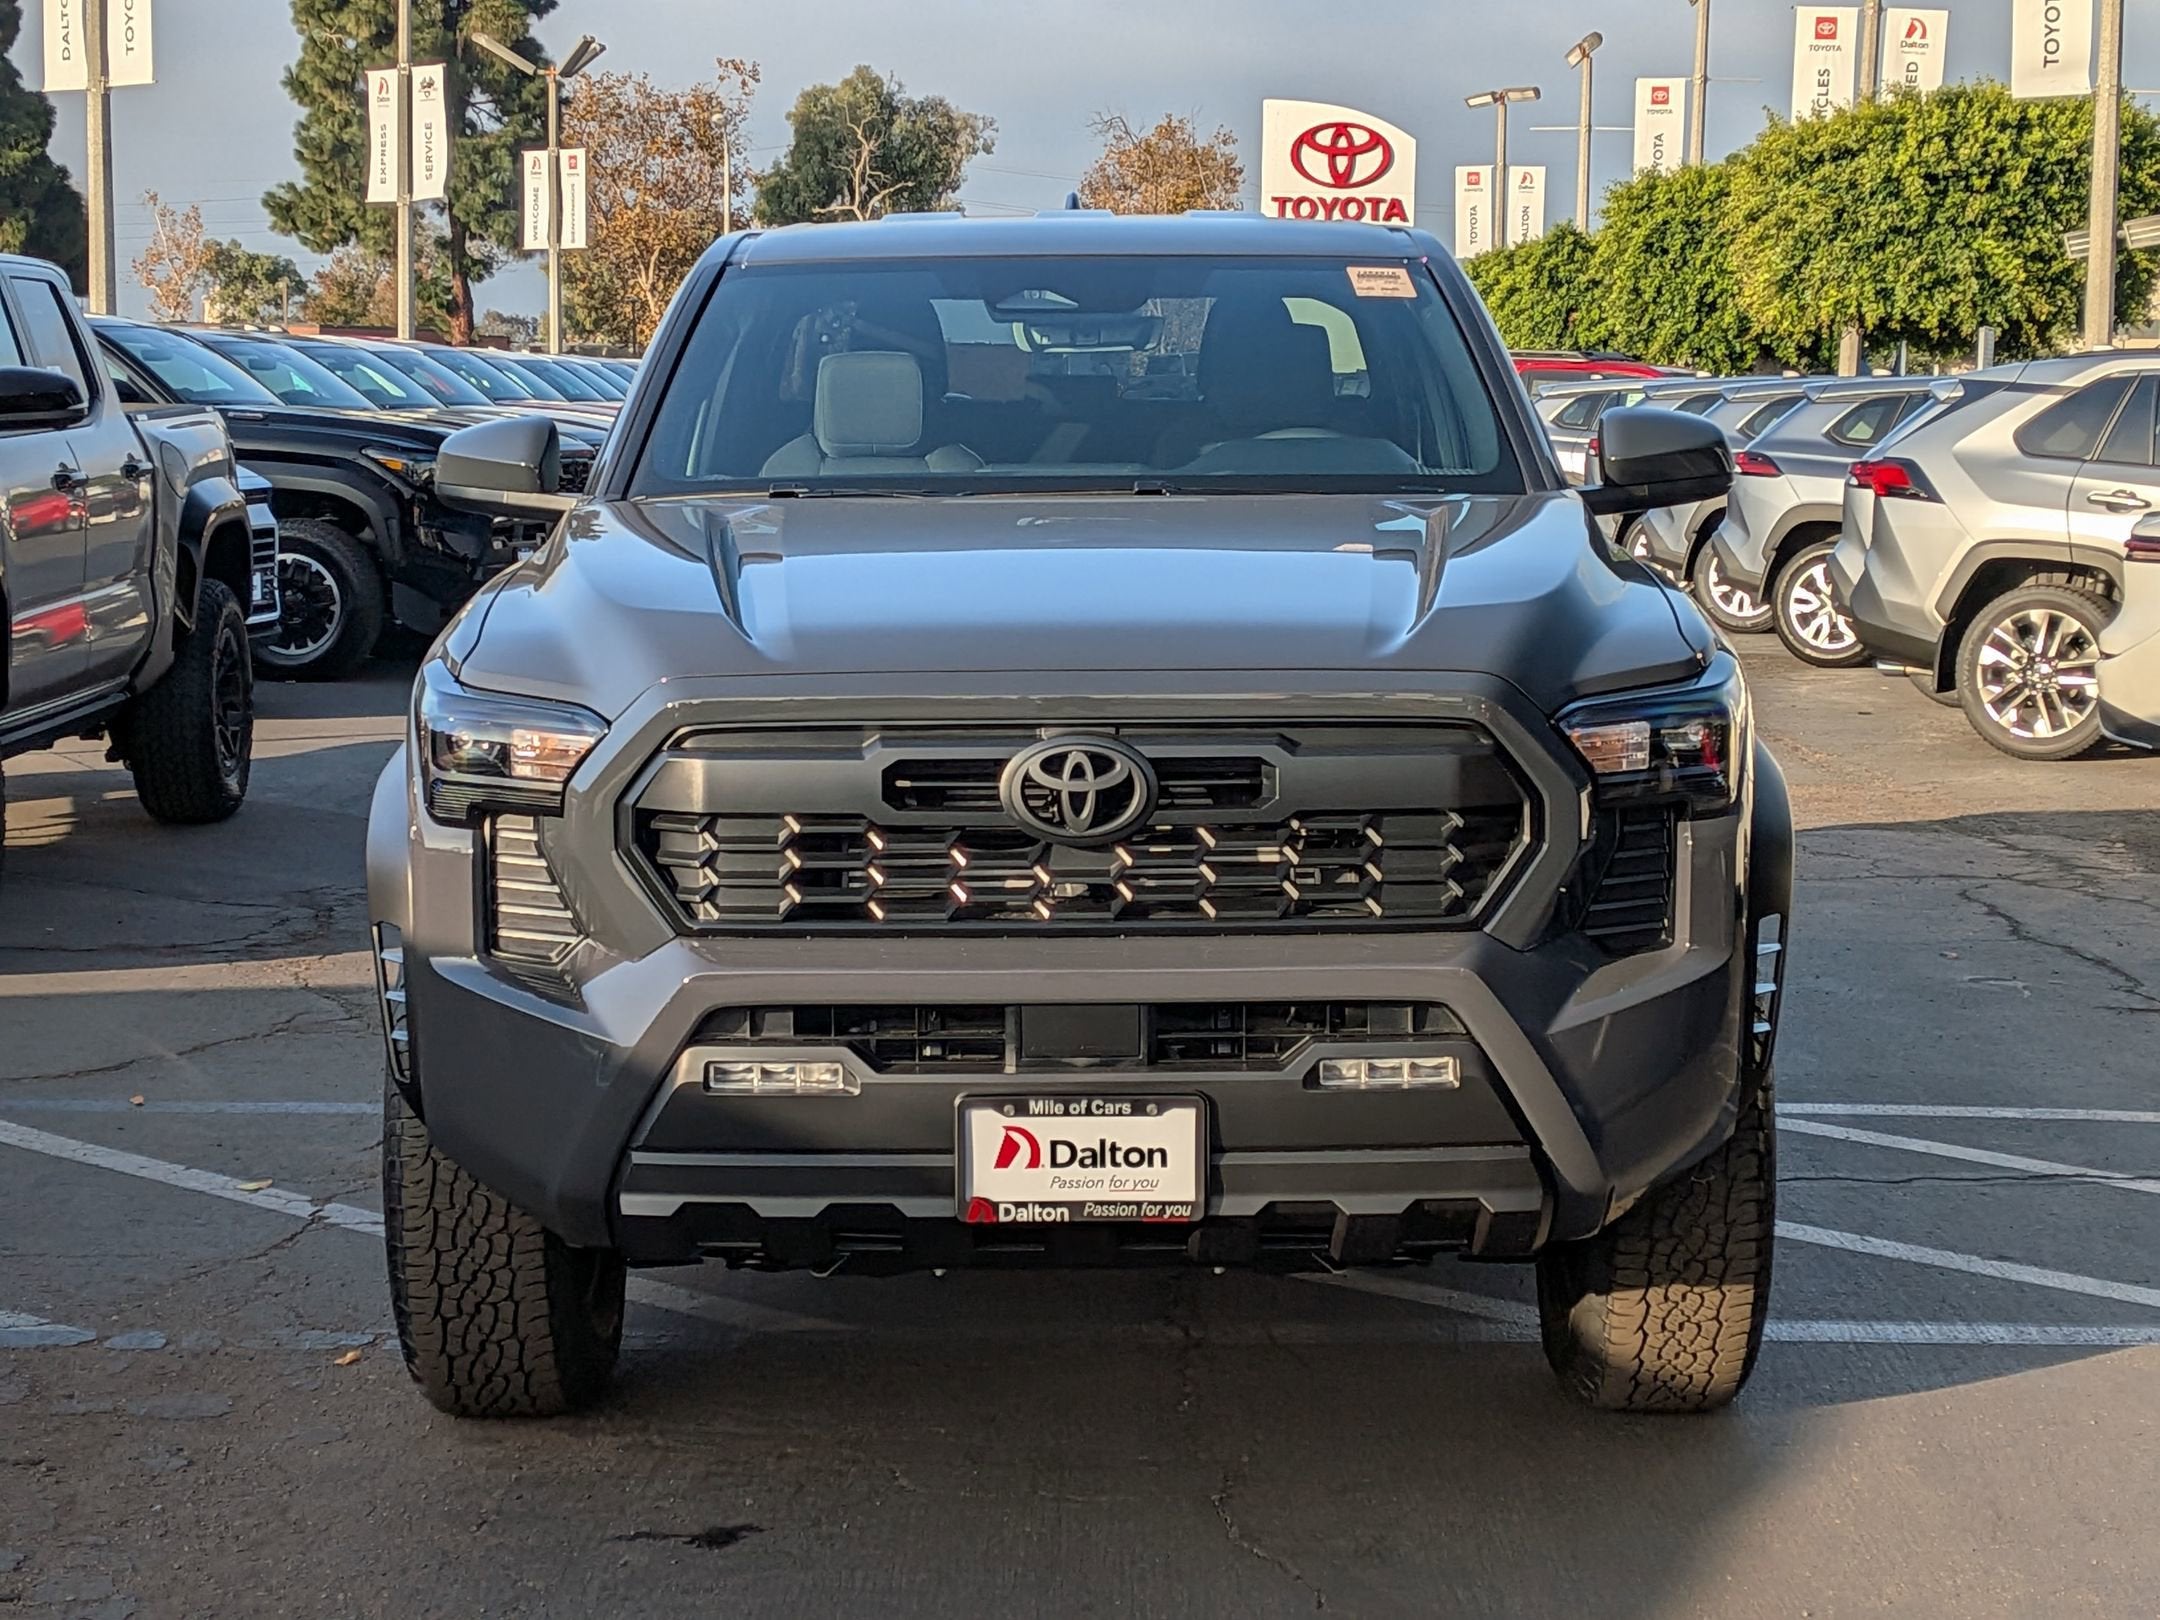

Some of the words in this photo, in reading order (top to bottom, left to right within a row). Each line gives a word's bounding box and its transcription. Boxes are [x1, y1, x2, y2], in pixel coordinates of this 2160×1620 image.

[1809, 44, 1842, 52] TOYOTA
[1900, 40, 1929, 49] Dalton
[425, 122, 433, 181] SERVICE
[1271, 196, 1409, 223] TOYOTA
[1470, 205, 1478, 245] TOYOTA
[1029, 1100, 1063, 1115] Mile
[1069, 1100, 1087, 1115] of
[1091, 1100, 1132, 1115] Cars
[1049, 1138, 1168, 1169] Dalton
[1050, 1176, 1104, 1189] Passion
[1109, 1175, 1129, 1190] for
[1131, 1178, 1160, 1190] you
[998, 1202, 1070, 1222] Dalton
[1083, 1202, 1138, 1217] Passion
[1141, 1201, 1162, 1217] for
[1163, 1204, 1192, 1219] you
